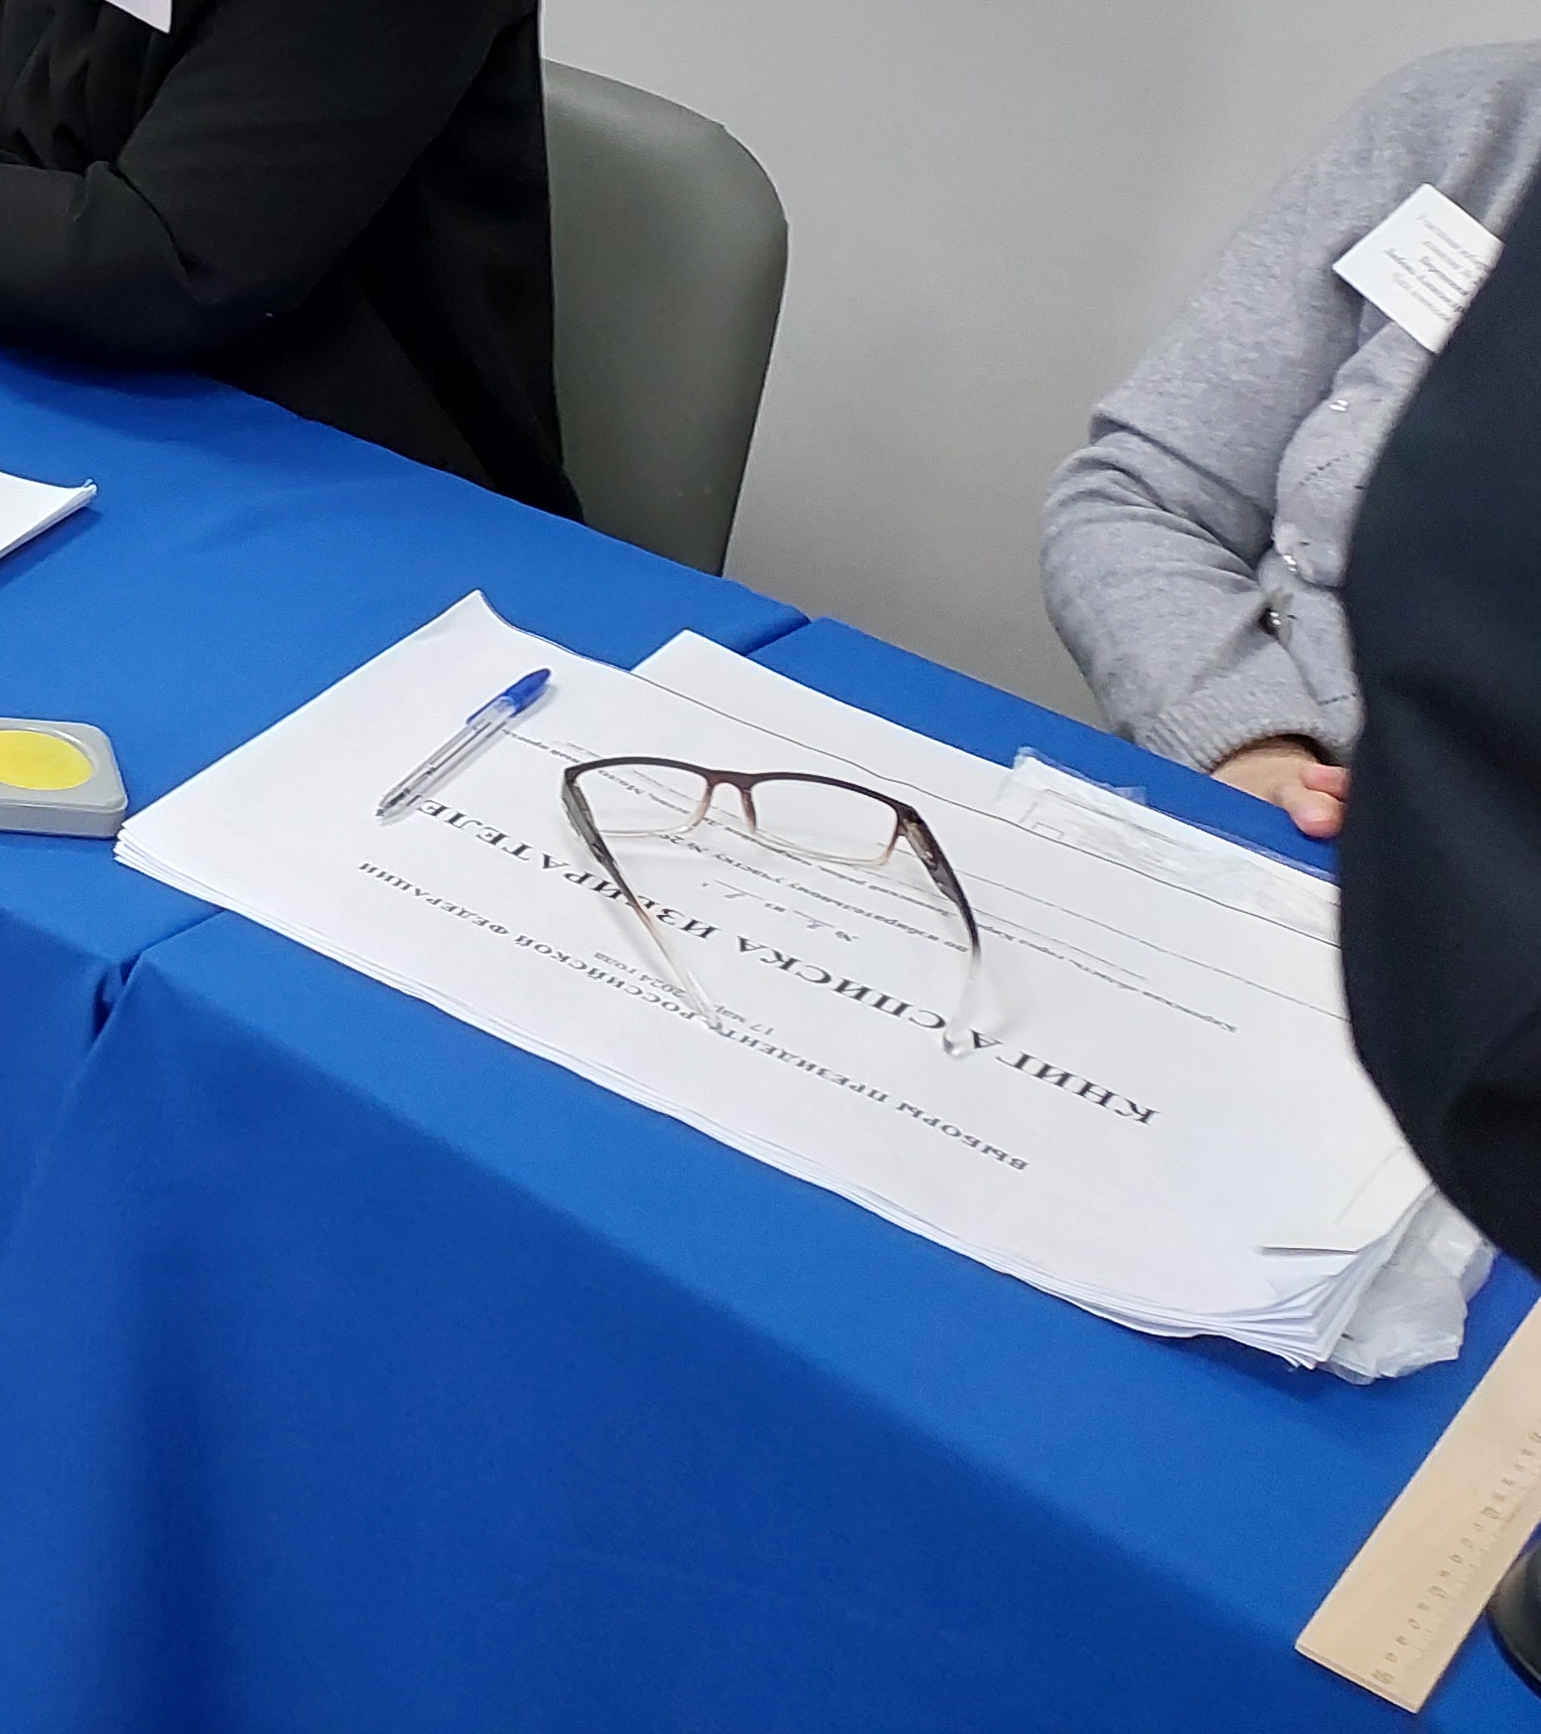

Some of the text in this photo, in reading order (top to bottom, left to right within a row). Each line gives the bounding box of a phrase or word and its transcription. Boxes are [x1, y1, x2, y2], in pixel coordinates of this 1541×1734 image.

[357, 862, 509, 936] ФЕДЕРАЦИИ
[405, 791, 1160, 1125] КНИГА СПИСКА ИЗИРАТЕЛЕ
[515, 934, 696, 1020] РОССИЙСКОЙ
[638, 974, 688, 998] 2024
[895, 1101, 1030, 1172] ВЫБОРЫ
